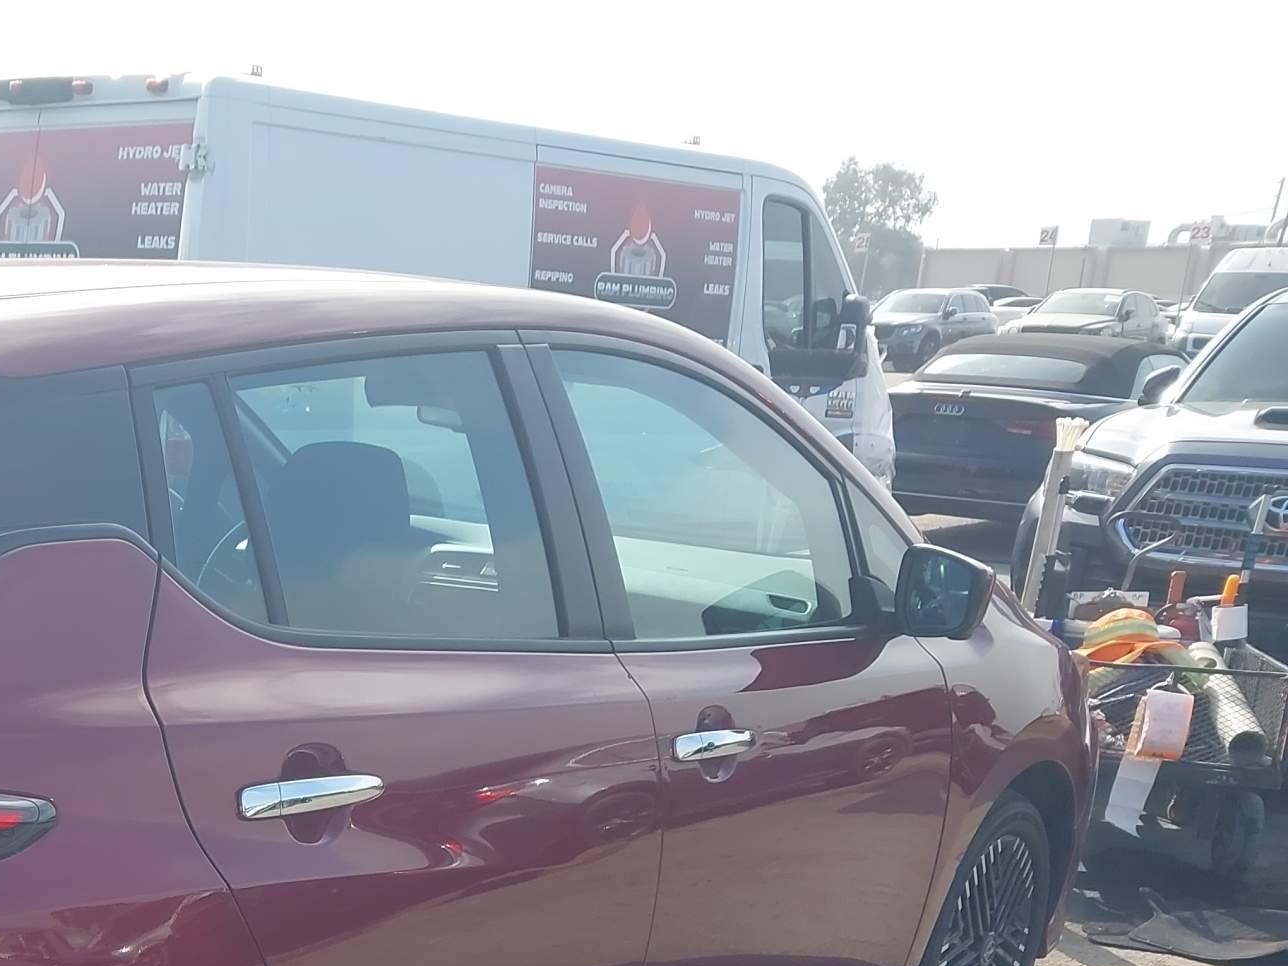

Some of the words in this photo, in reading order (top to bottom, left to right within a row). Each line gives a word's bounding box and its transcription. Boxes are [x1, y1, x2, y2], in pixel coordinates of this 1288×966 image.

[118, 145, 162, 161] HYDRO
[163, 144, 183, 160] JE
[140, 182, 182, 196] WATER
[539, 183, 573, 197] CAMERA
[131, 201, 180, 216] HEATER
[538, 198, 588, 213] INSPECTION
[694, 209, 721, 221] HYDRO
[721, 212, 736, 223] JET
[1040, 230, 1057, 243] 24
[1192, 226, 1209, 239] 23
[137, 235, 176, 249] LEAKS
[537, 232, 572, 246] SERVICE
[572, 235, 598, 248] CALLS
[534, 269, 574, 283] REPIPING
[597, 281, 620, 296] RAM
[622, 283, 674, 299] PLUMBING
[703, 282, 731, 296] LEAKS
